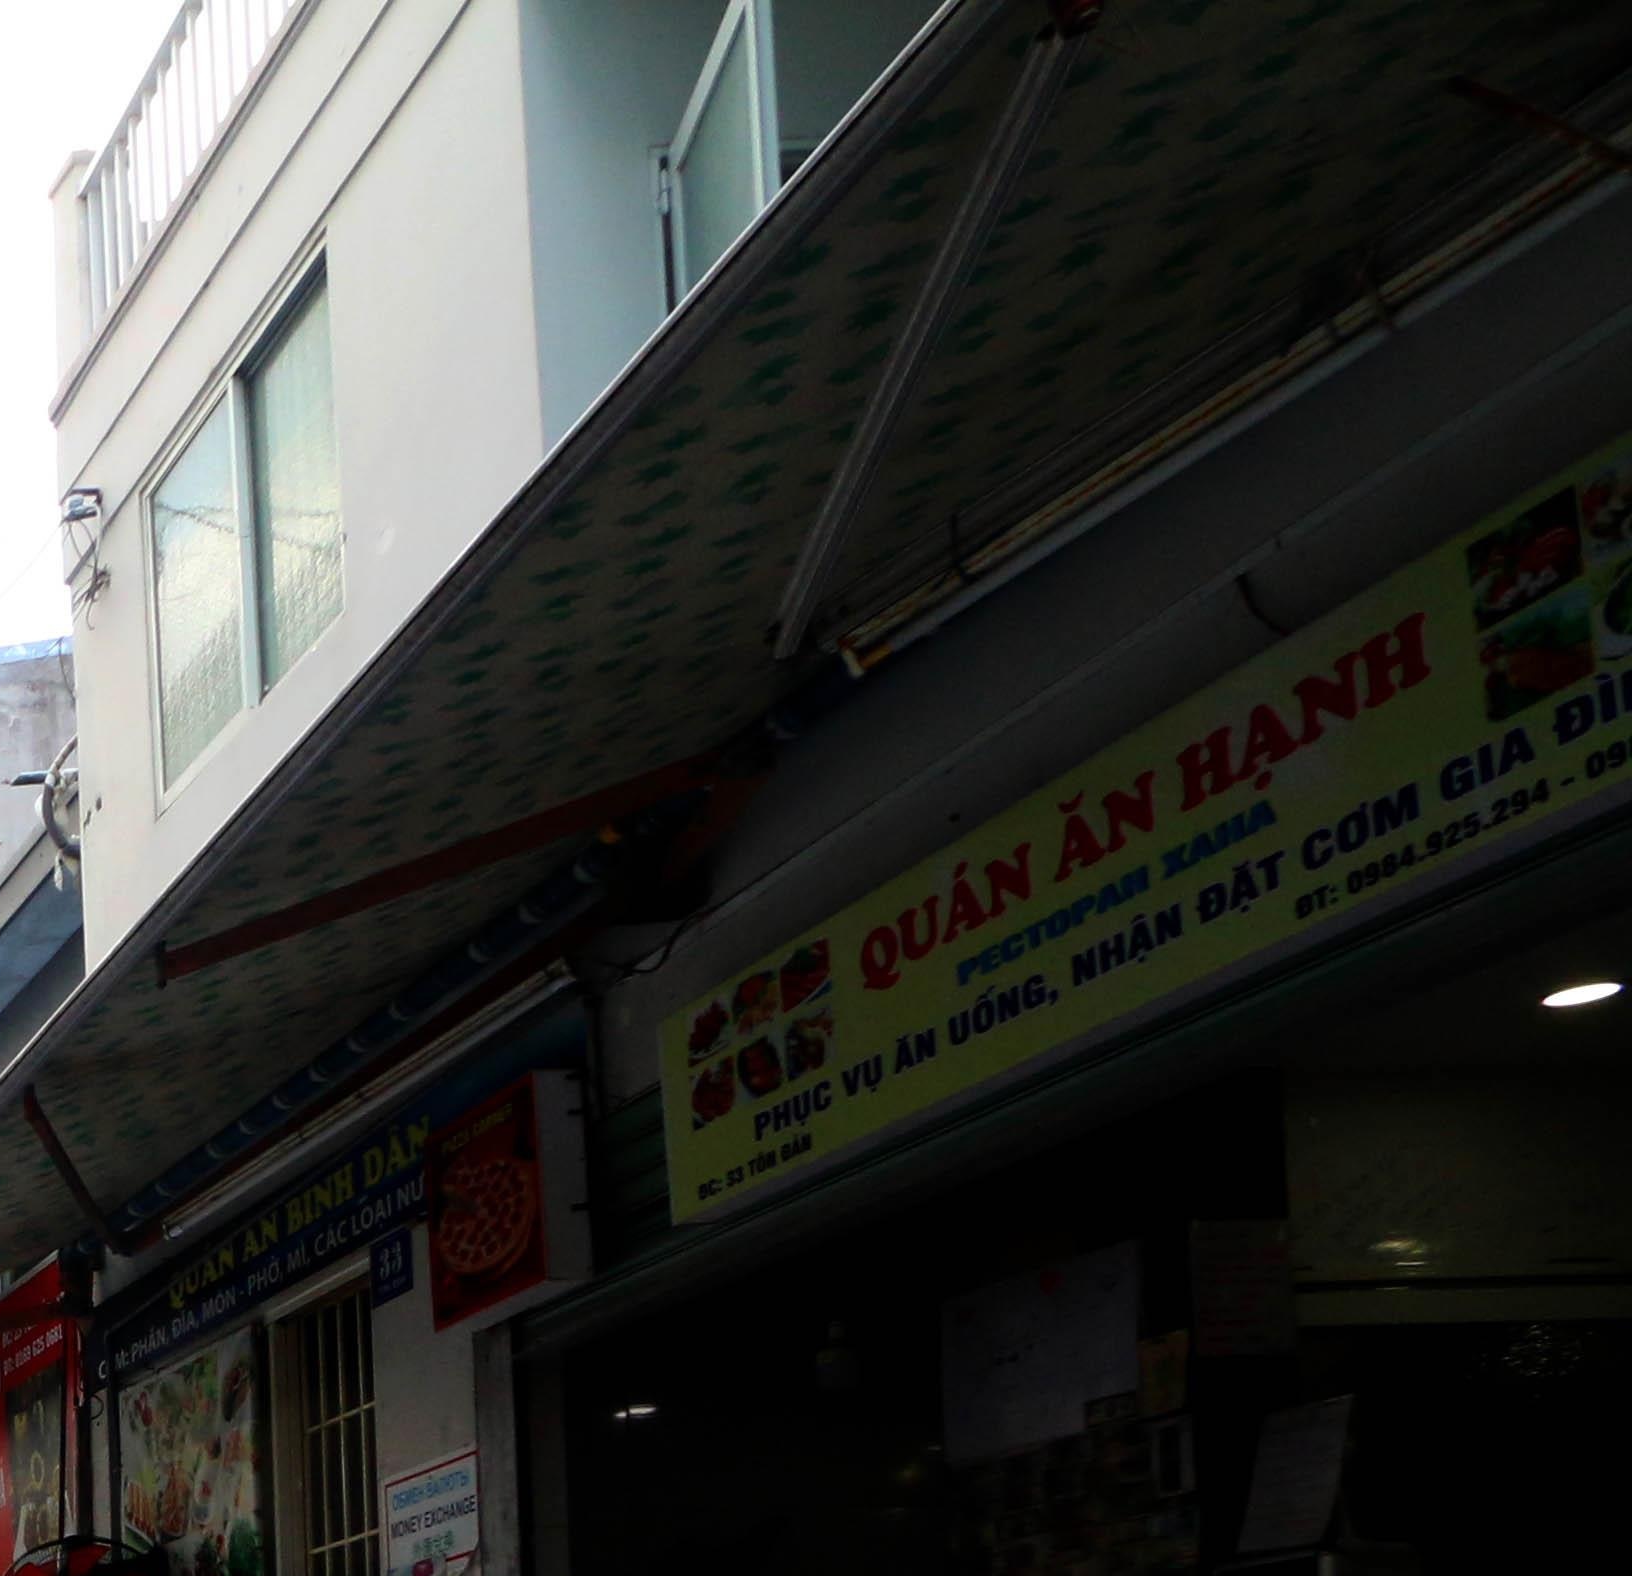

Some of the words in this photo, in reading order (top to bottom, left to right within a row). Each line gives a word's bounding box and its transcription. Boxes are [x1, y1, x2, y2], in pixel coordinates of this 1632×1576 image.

[754, 1080, 833, 1142] PHỤC
[842, 1054, 883, 1098] VỤ
[895, 1027, 936, 1076] ĂN
[947, 973, 1060, 1047] UỐNG,
[1071, 904, 1184, 986] NHẬN
[1196, 851, 1287, 924] ĐẶT
[1301, 783, 1419, 871] CƠM
[1439, 727, 1535, 803] GIA
[1551, 668, 1632, 747] ĐÌ
[861, 843, 1031, 990] QUÁN
[1054, 770, 1156, 882] ĂN
[1176, 611, 1432, 813] HẠNH
[1347, 781, 1551, 894] 0984.925.294
[1584, 736, 1632, 780] 09
[391, 1514, 423, 1538] MONEY
[423, 1495, 476, 1529] EXCHANGE
